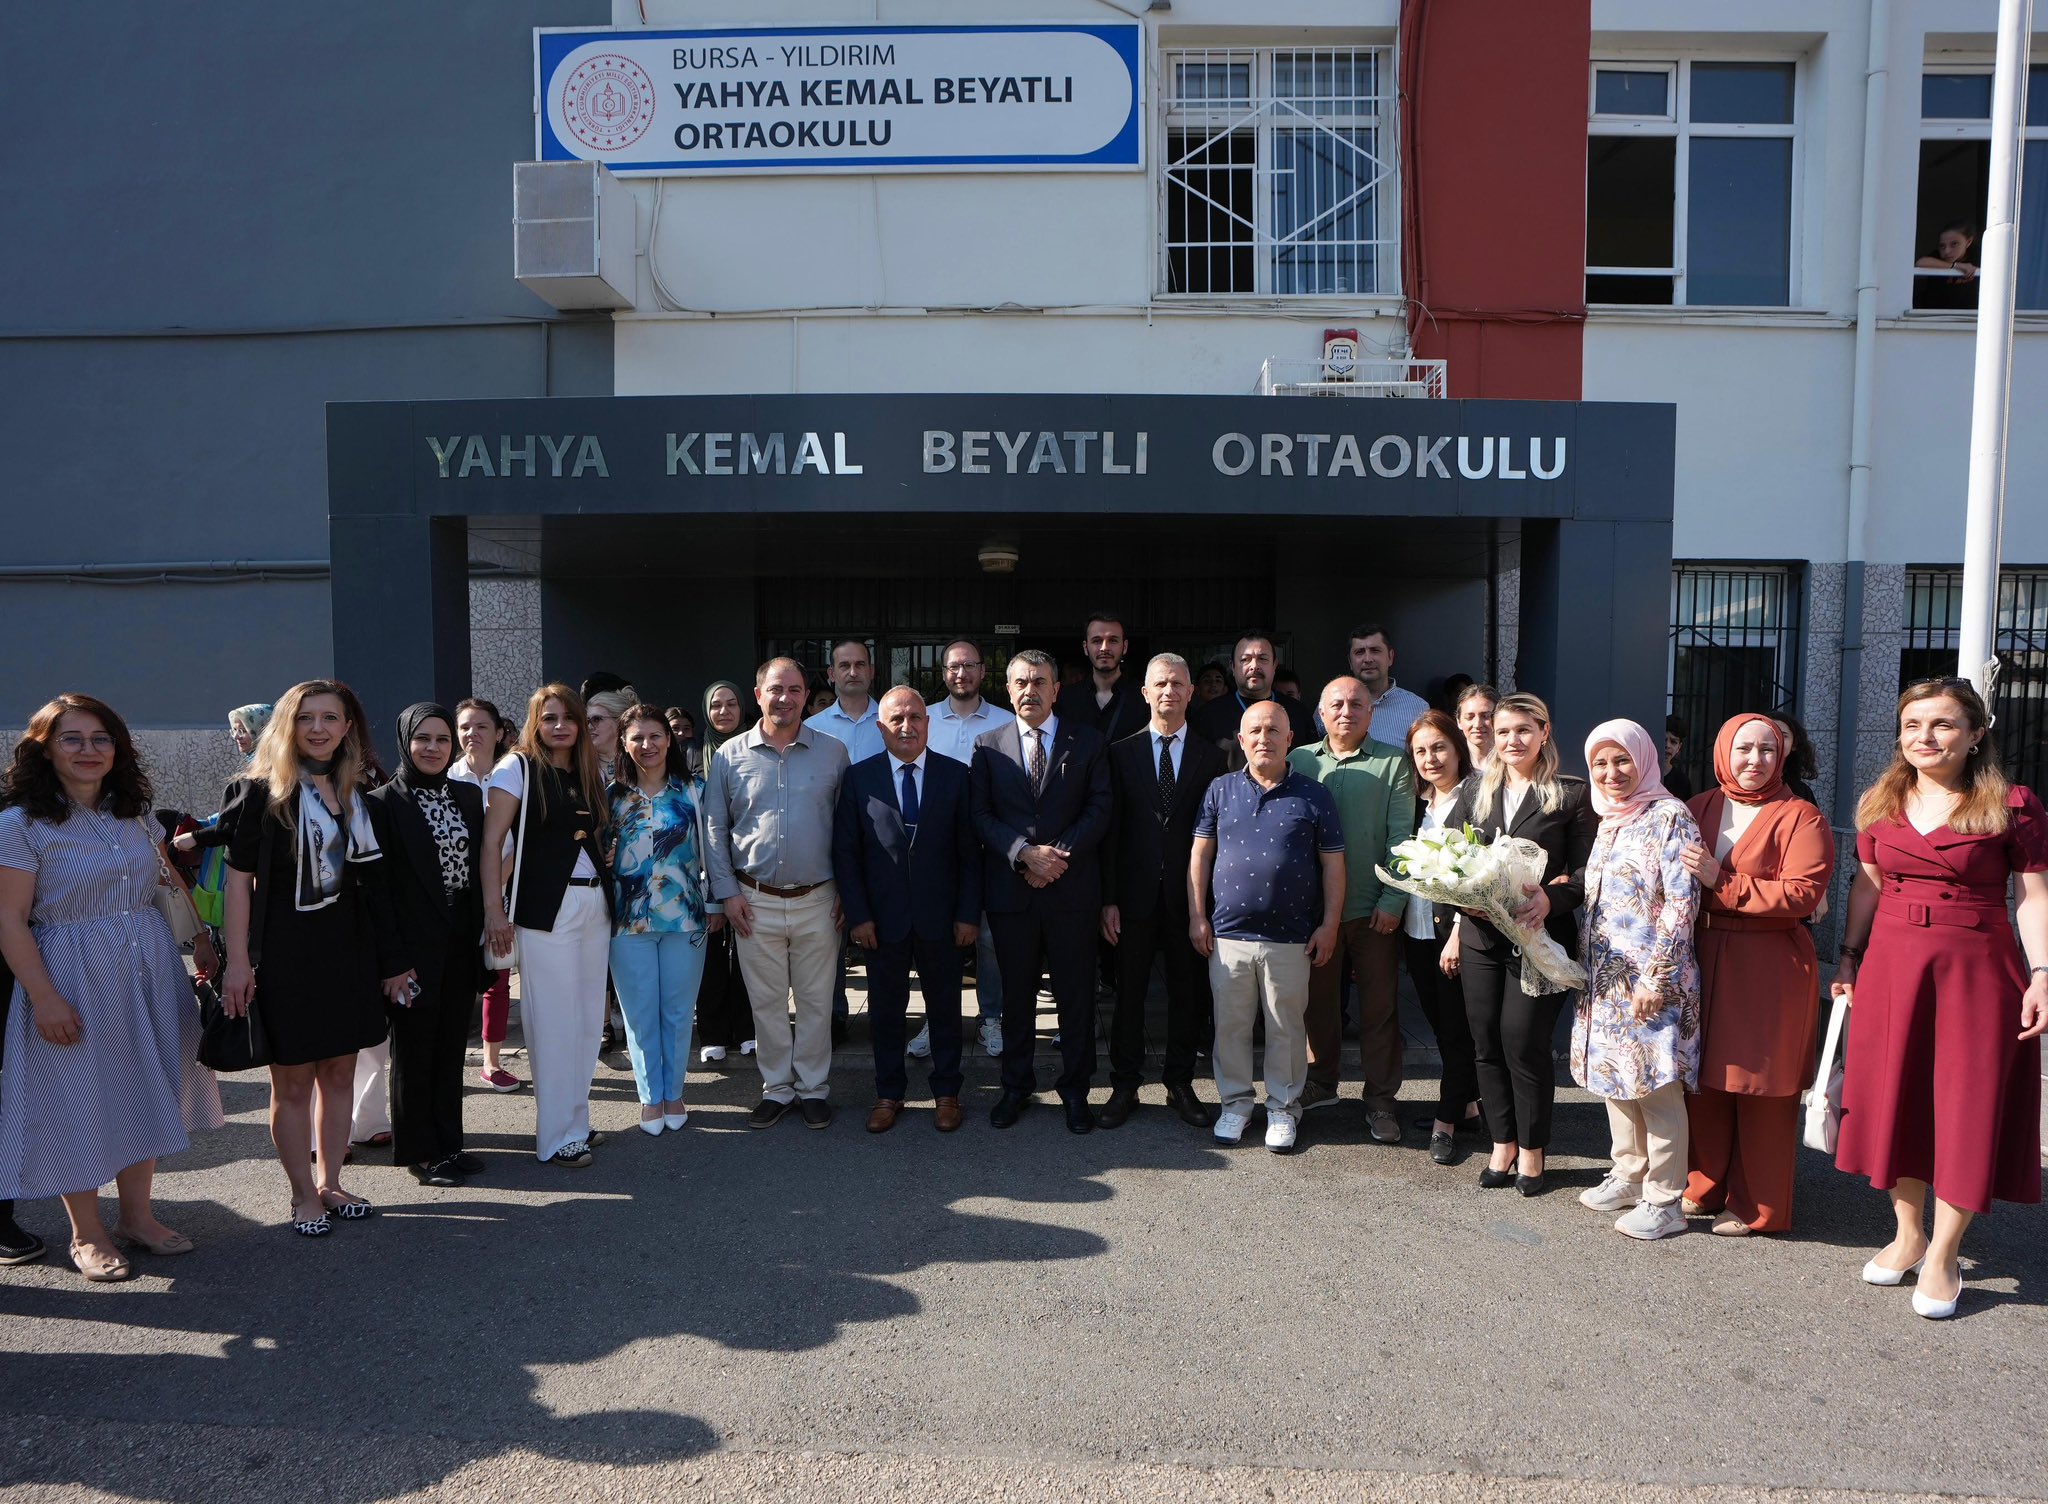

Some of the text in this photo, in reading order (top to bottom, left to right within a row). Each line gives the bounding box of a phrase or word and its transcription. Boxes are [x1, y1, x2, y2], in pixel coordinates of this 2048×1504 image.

[673, 47, 759, 70] BURSA
[780, 44, 896, 69] YILDIRIM
[673, 76, 1073, 109] YAHYA KEMAL BEYATLI
[674, 119, 892, 151] ORTAOKULU
[426, 430, 1567, 481] YAHYA KEMAL BEYATLI ORTAOKULU
